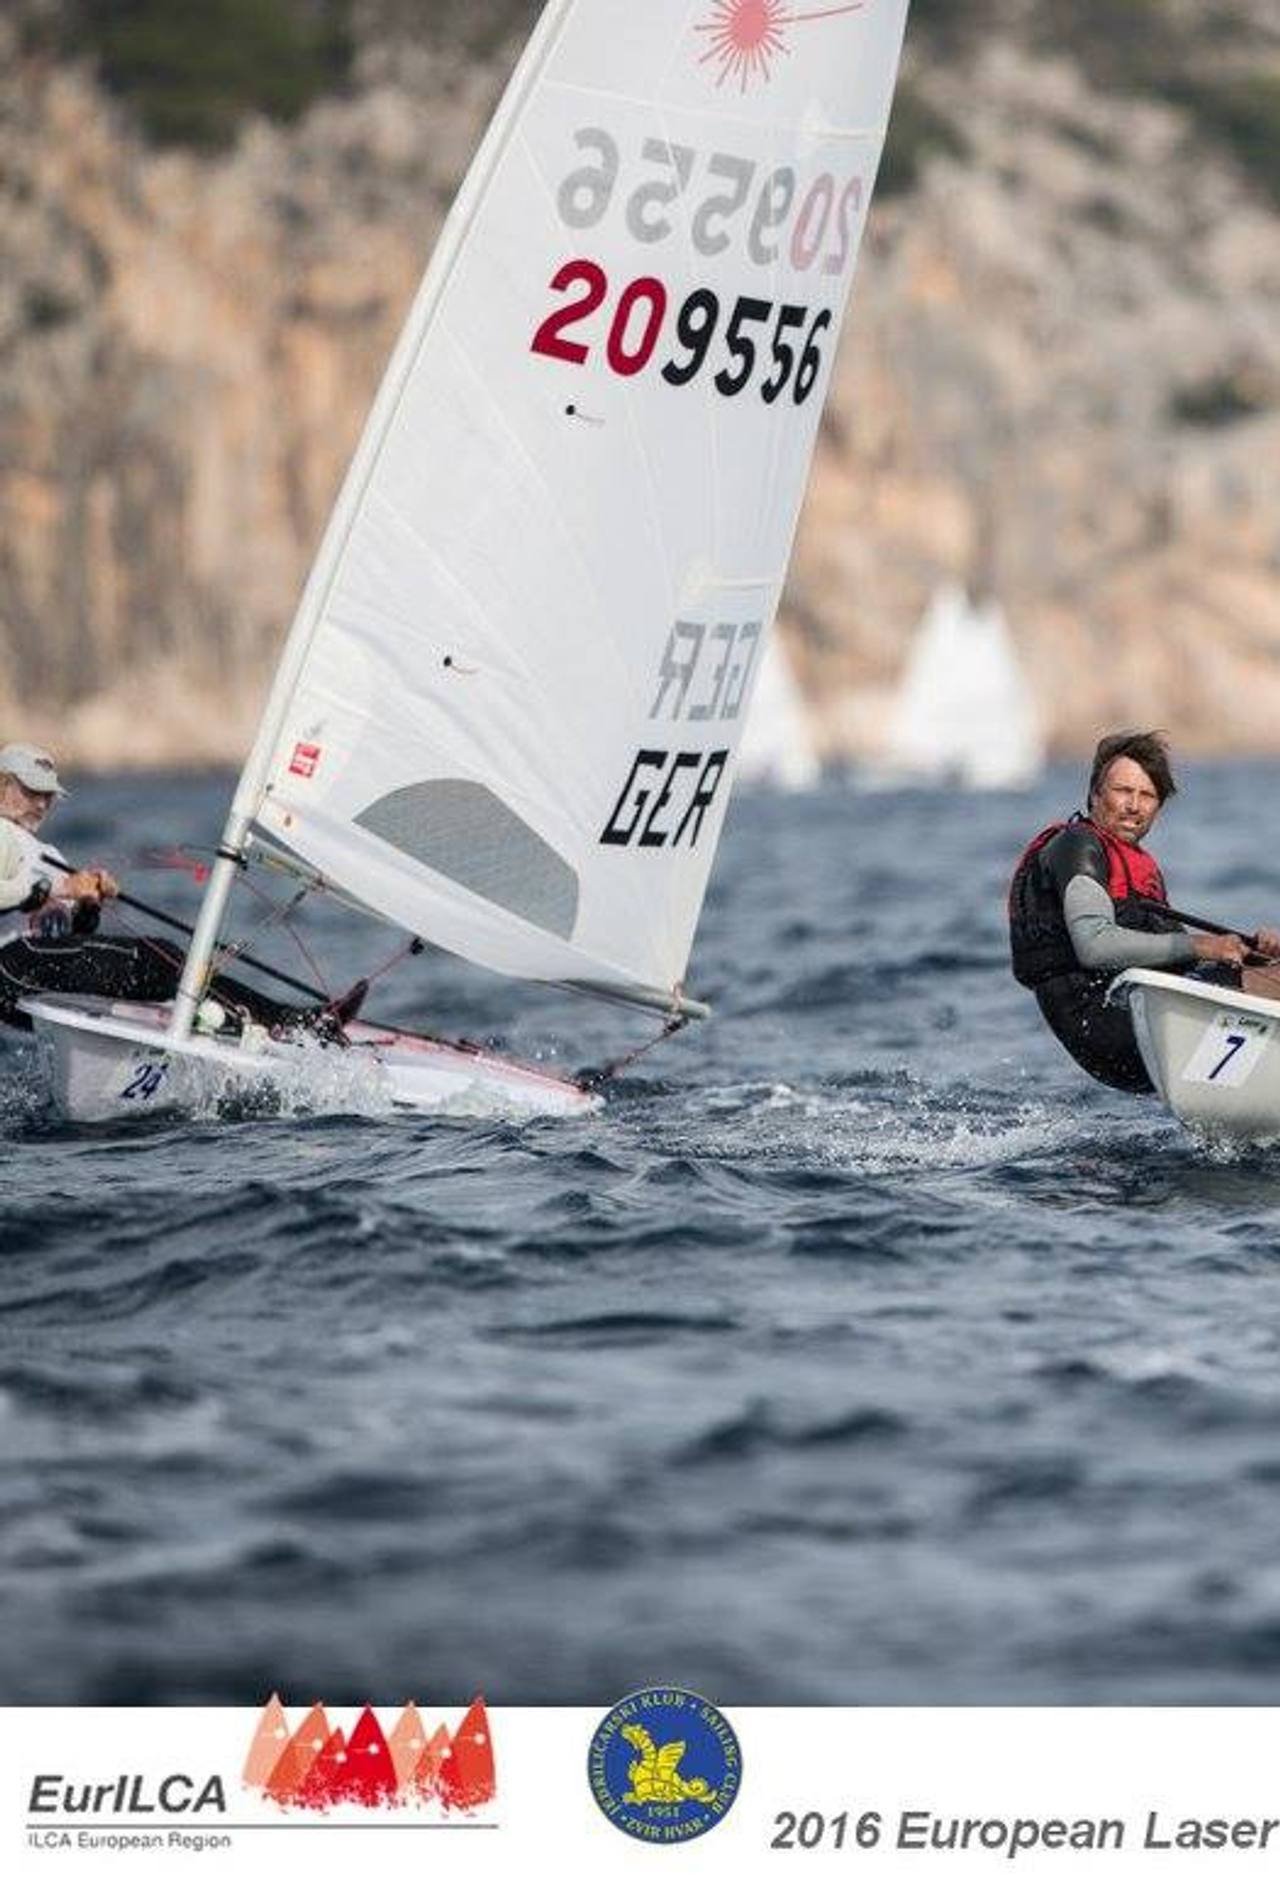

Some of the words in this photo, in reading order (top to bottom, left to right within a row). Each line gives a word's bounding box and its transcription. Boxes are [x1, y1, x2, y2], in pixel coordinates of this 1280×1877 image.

[531, 259, 832, 405] 209556
[599, 749, 729, 847] GER
[120, 1063, 162, 1100] 24
[1208, 1034, 1246, 1080] 7
